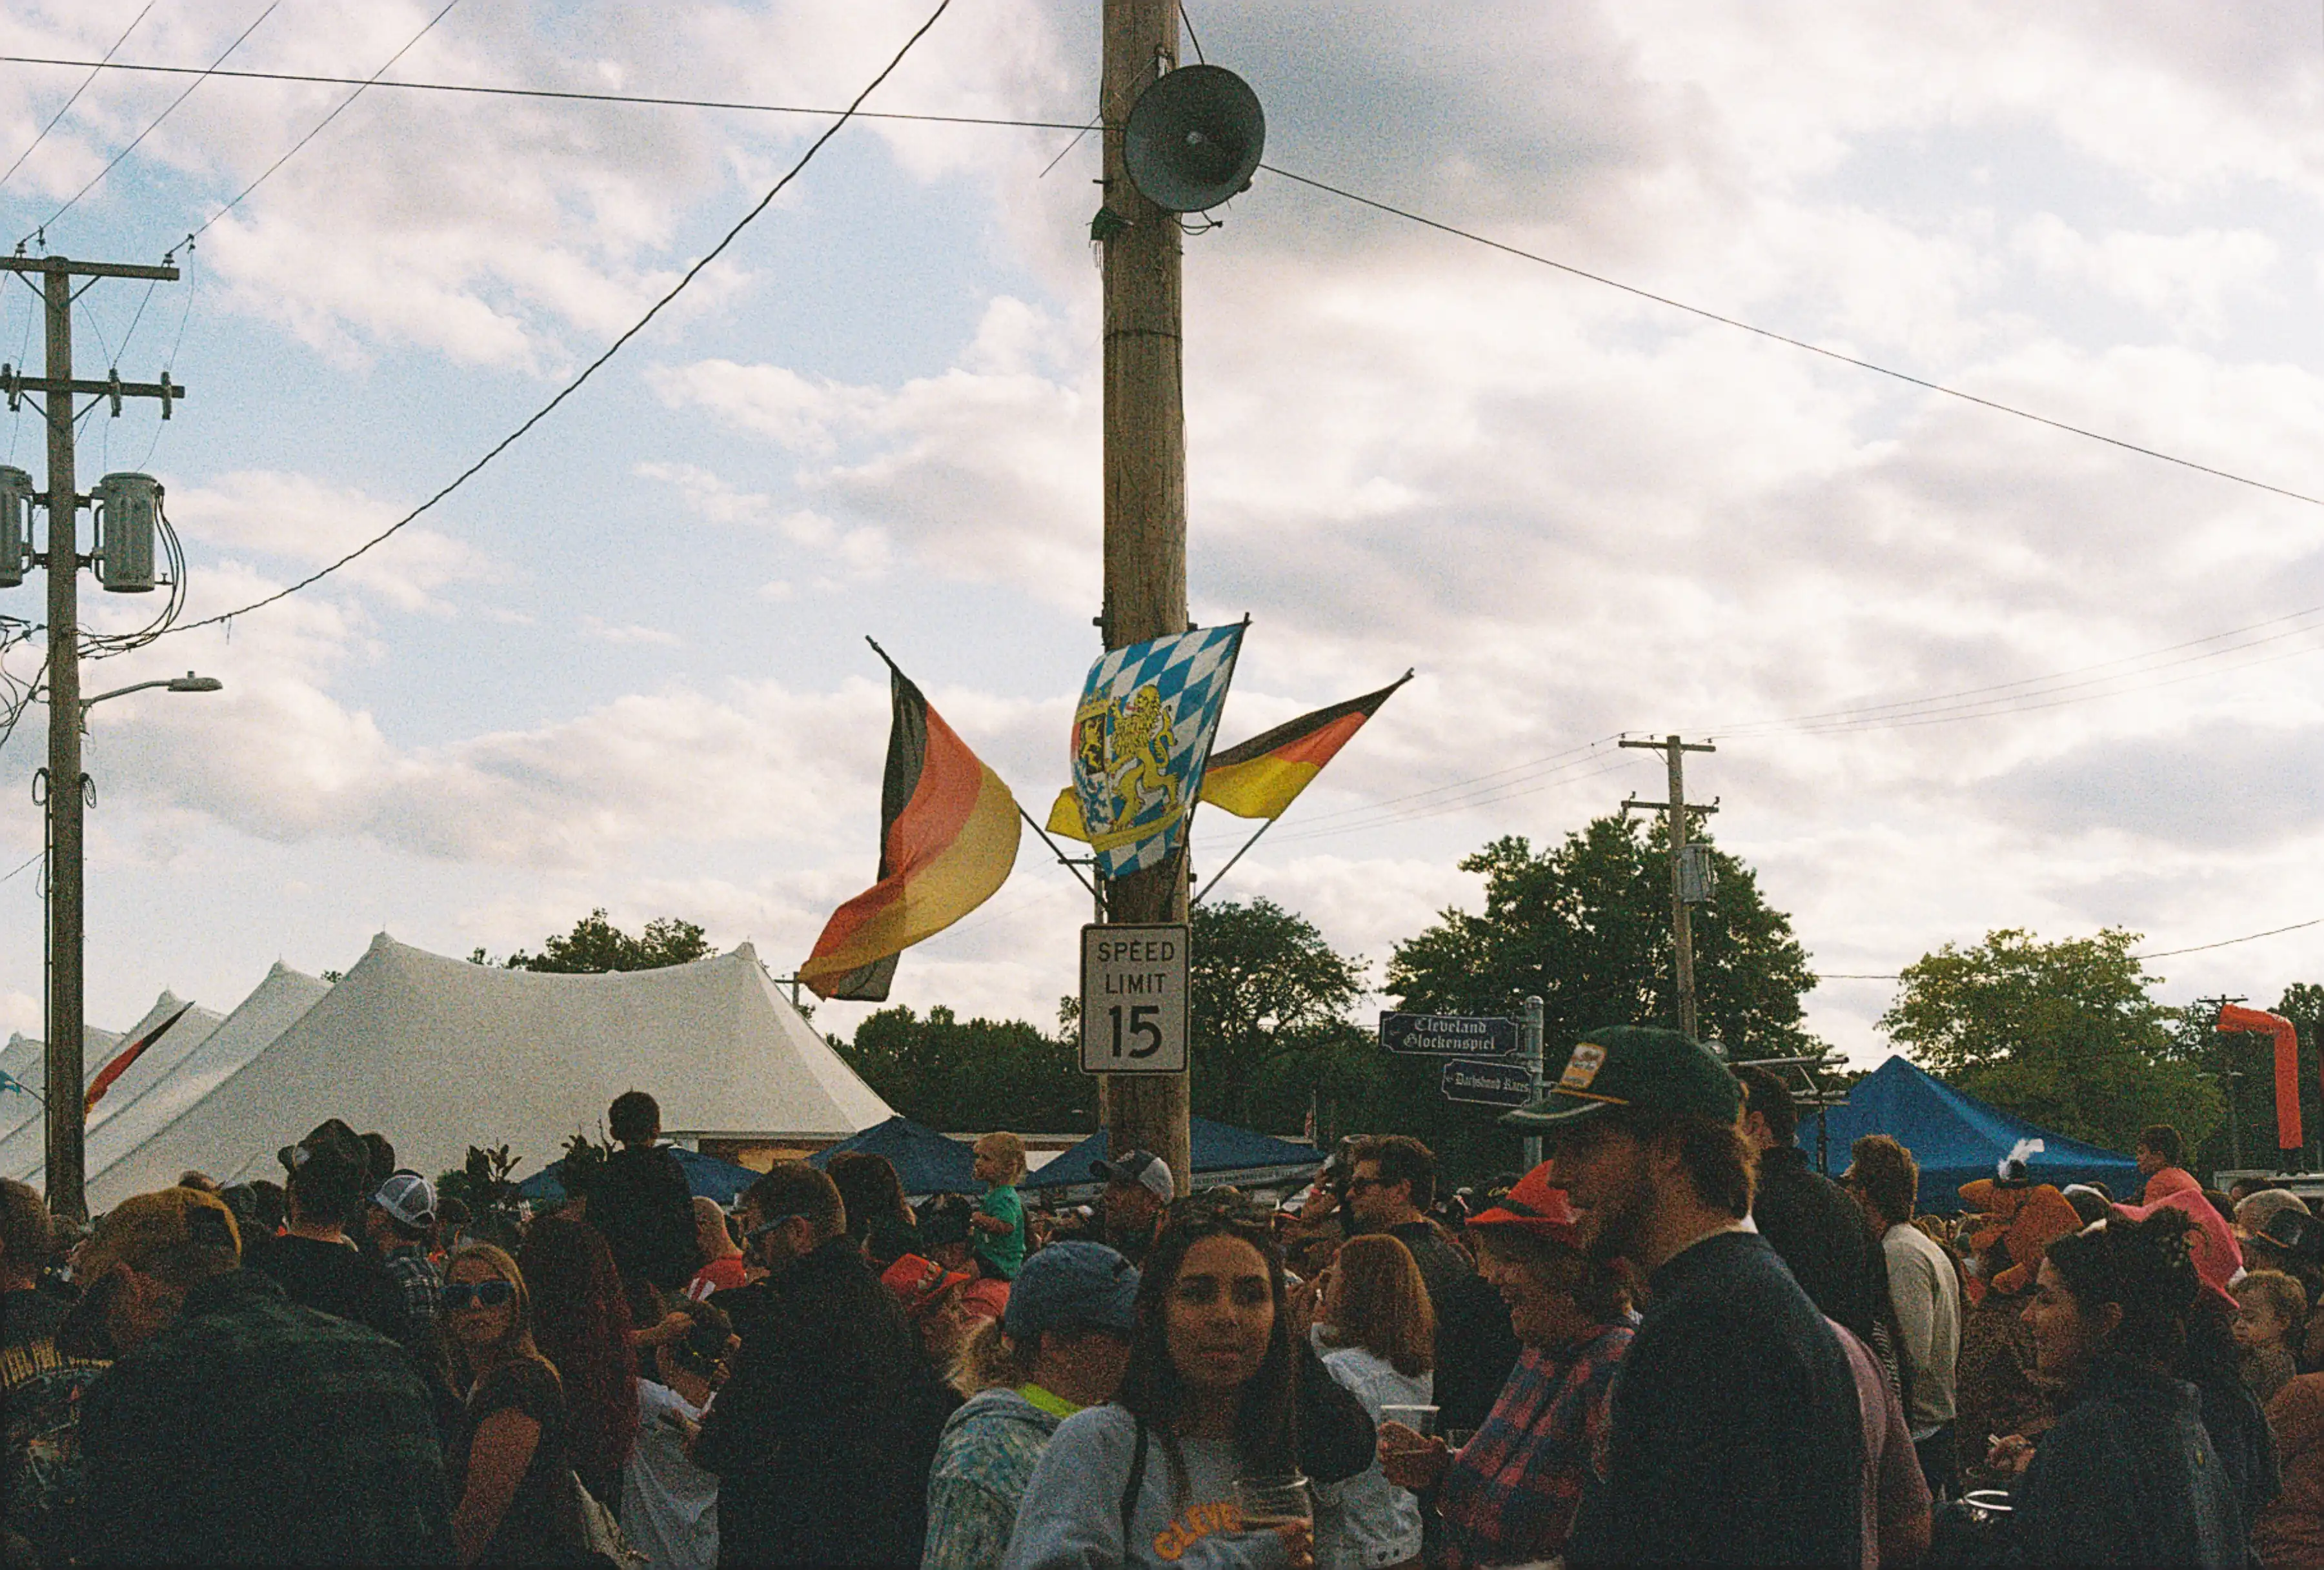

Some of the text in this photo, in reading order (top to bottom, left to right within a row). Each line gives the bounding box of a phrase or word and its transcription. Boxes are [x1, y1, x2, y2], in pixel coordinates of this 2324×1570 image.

[1097, 941, 1175, 962] SPEED
[1105, 973, 1167, 994] LIMIT
[1109, 1005, 1162, 1059] 15
[1414, 1017, 1487, 1034] Cleveland
[1402, 1033, 1495, 1051] Glockenspiel
